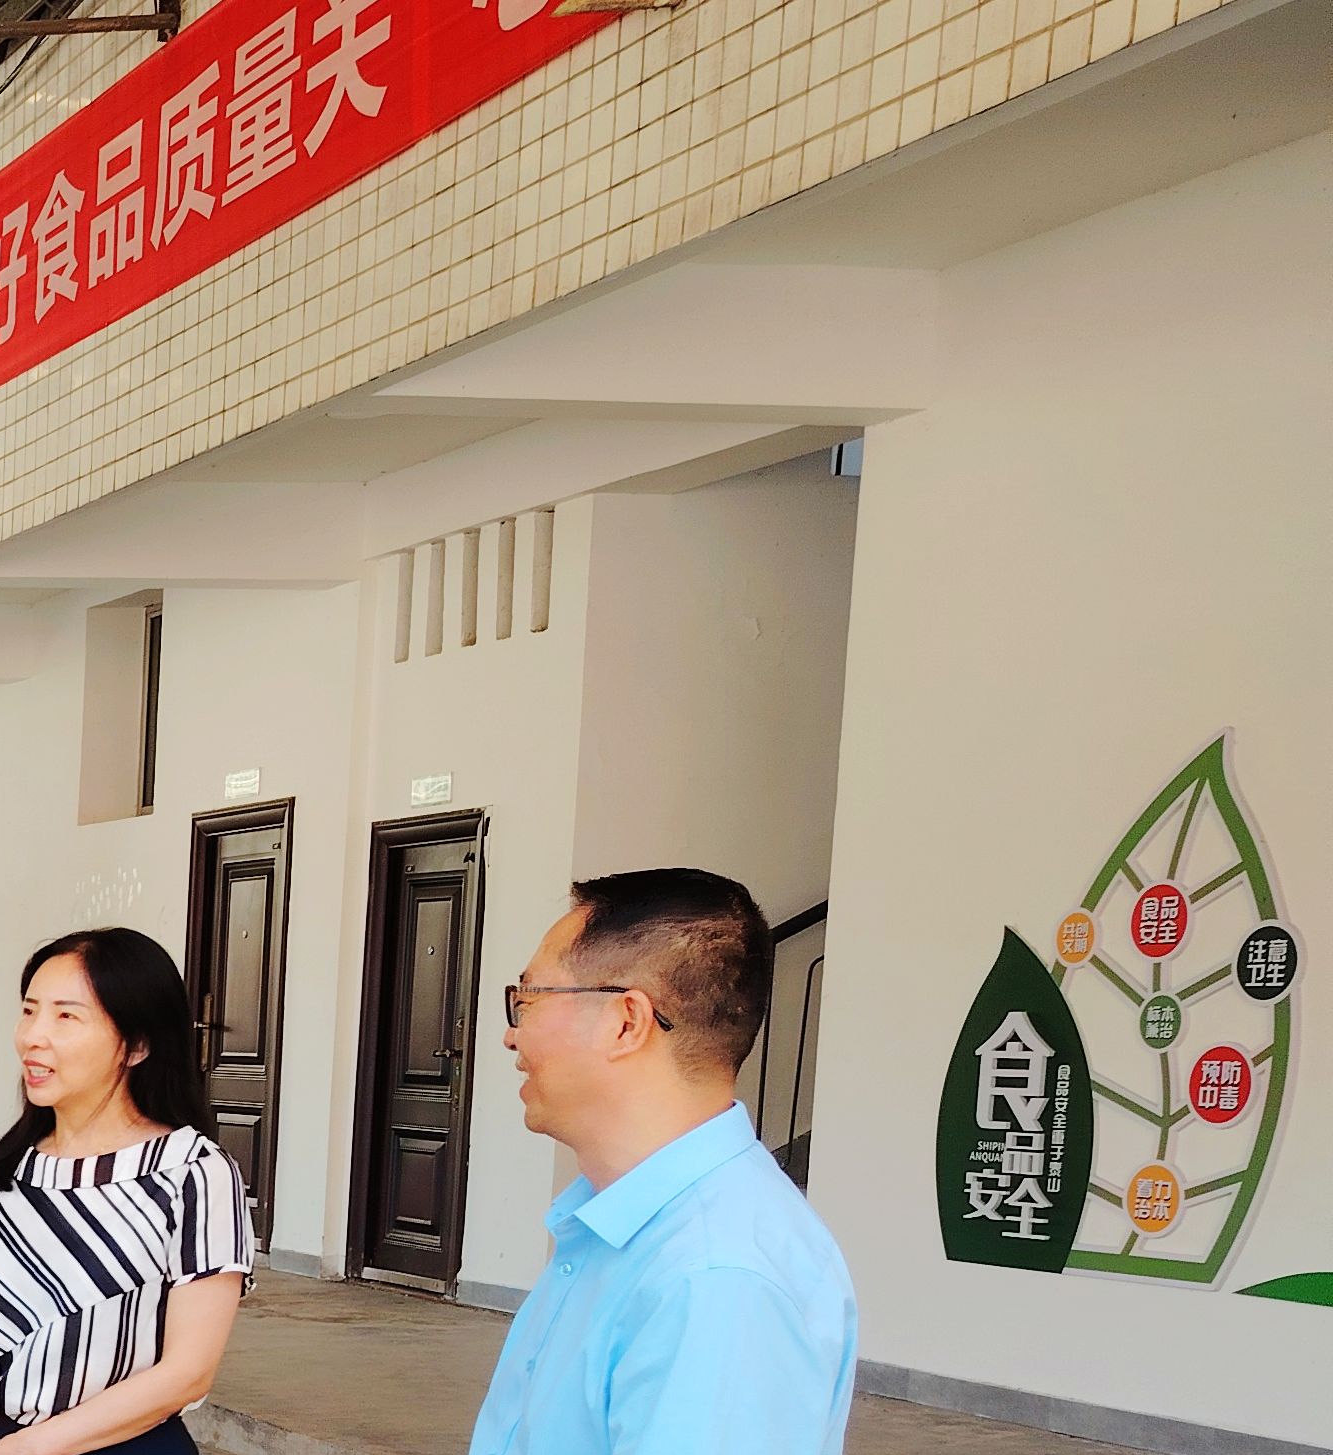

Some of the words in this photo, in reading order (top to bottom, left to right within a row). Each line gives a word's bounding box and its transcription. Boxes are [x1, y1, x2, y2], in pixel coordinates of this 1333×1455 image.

[1140, 895, 1180, 920] 食品
[1139, 920, 1179, 944] 安全
[1248, 938, 1289, 963] 注意
[1245, 964, 1287, 988] 卫生
[1146, 1004, 1176, 1023] 标本
[1200, 1060, 1242, 1086] 预防
[1198, 1085, 1240, 1110] 中毒
[1134, 1199, 1171, 1221] 治本
